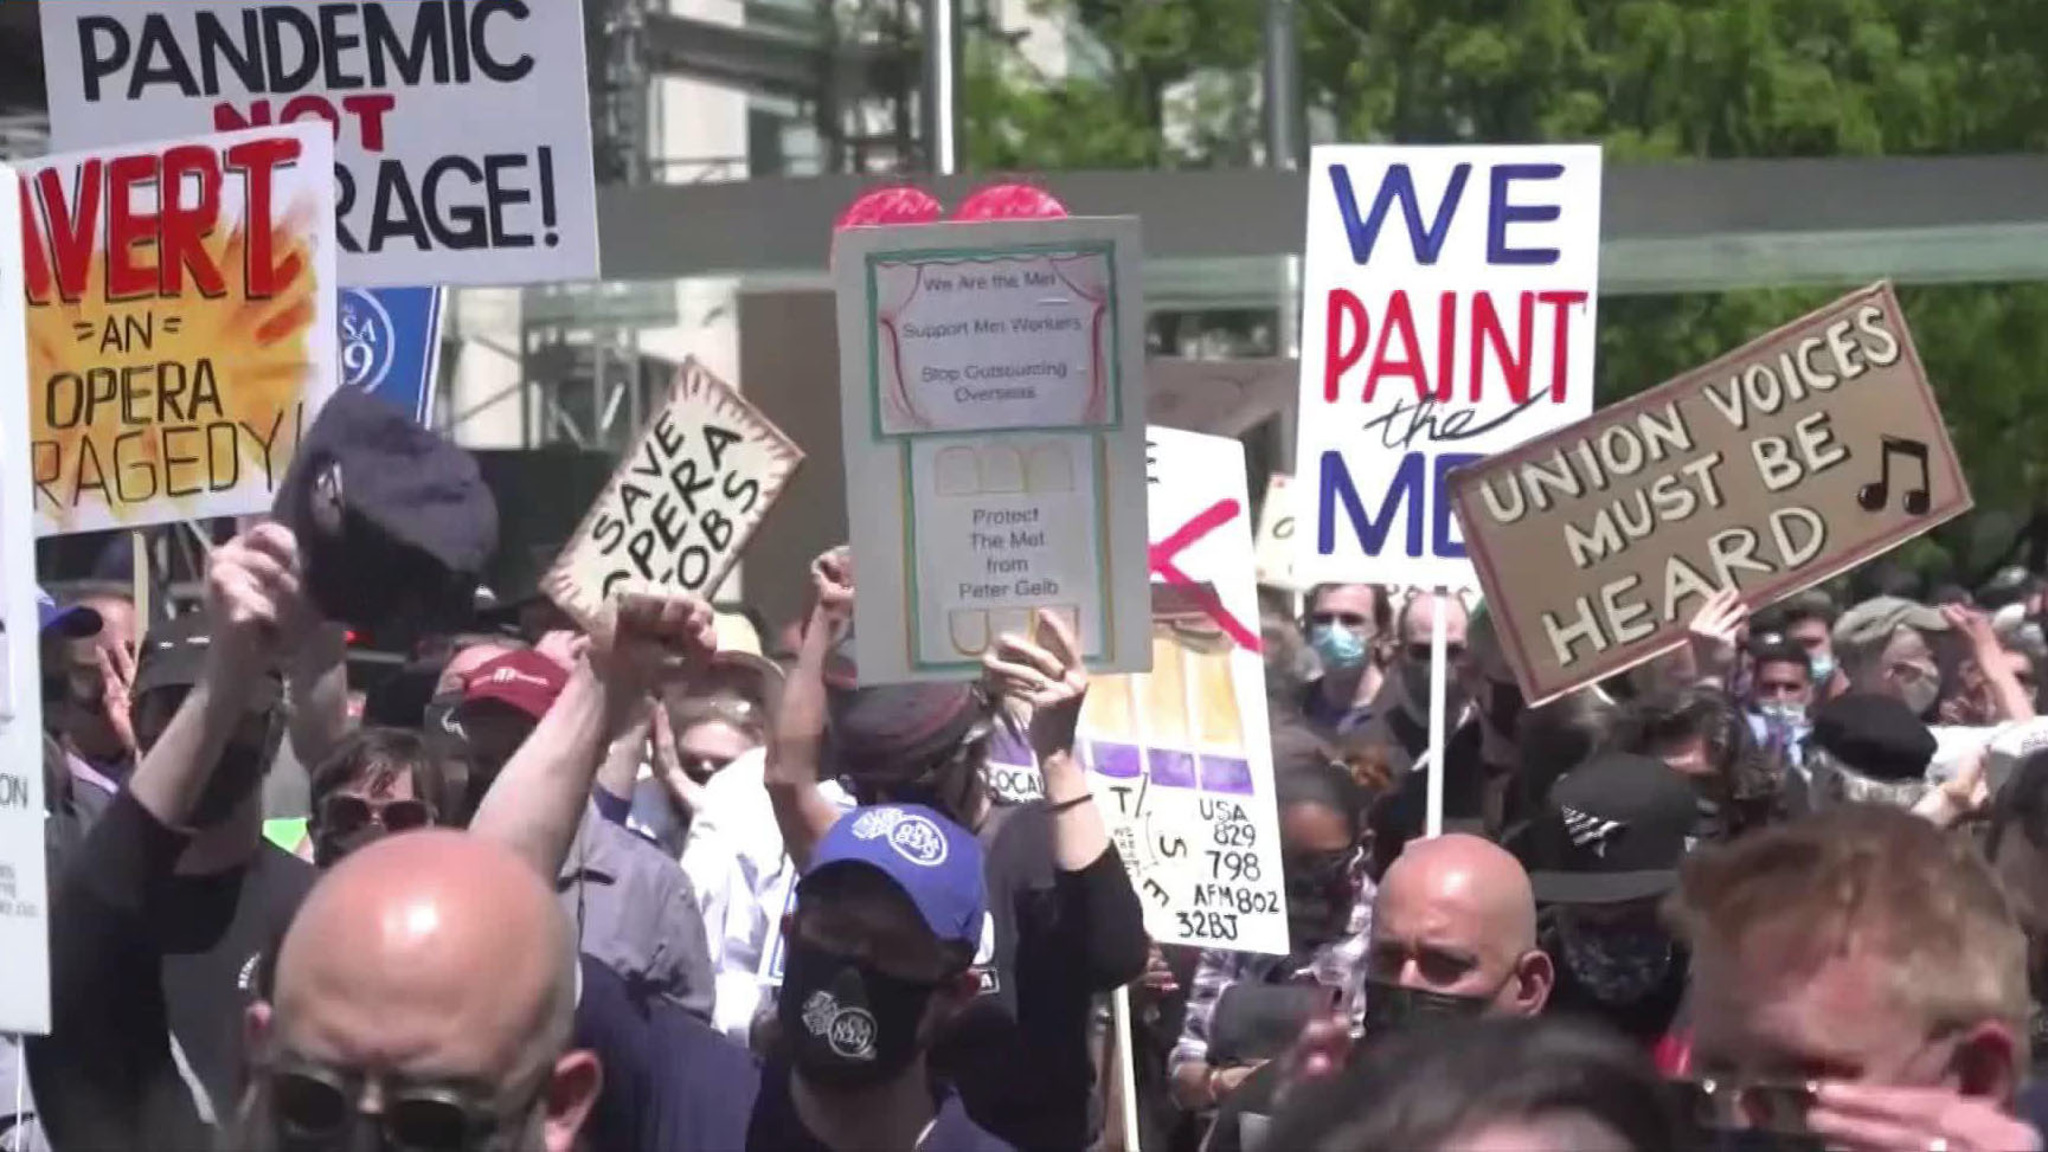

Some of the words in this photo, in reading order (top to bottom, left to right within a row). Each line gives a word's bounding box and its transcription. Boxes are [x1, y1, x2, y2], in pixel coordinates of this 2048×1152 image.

[77, 0, 535, 102] PANDEMIC
[1328, 162, 1566, 266] WE
[923, 277, 953, 293] We
[957, 272, 987, 291] Are
[992, 273, 1019, 289] the
[902, 320, 970, 341] Support
[1011, 316, 1082, 335] Workers
[1323, 287, 1589, 404] PAINT
[920, 364, 961, 384] Stop
[963, 359, 1068, 382] Outsourcing
[46, 358, 224, 430] OPERA
[953, 385, 1037, 404] Overseas
[1363, 391, 1551, 450] the
[1479, 400, 1694, 525] UNION
[1702, 305, 1899, 430] VOICES
[592, 409, 685, 556] SAVE
[1563, 450, 1724, 570] MUST
[1751, 410, 1849, 494] BE
[659, 470, 760, 590] OBS
[972, 506, 1040, 526] Protect
[970, 532, 1005, 550] The
[1010, 531, 1045, 549] Met
[986, 556, 1029, 574] from
[958, 582, 1009, 600] Peter
[1541, 506, 1827, 668] HEARD
[1199, 798, 1249, 822] USA
[1213, 823, 1256, 847] 829
[1204, 850, 1262, 882] 798
[1194, 883, 1234, 908] AFM
[1236, 890, 1280, 914] 802
[1175, 910, 1238, 941] 32BJ
